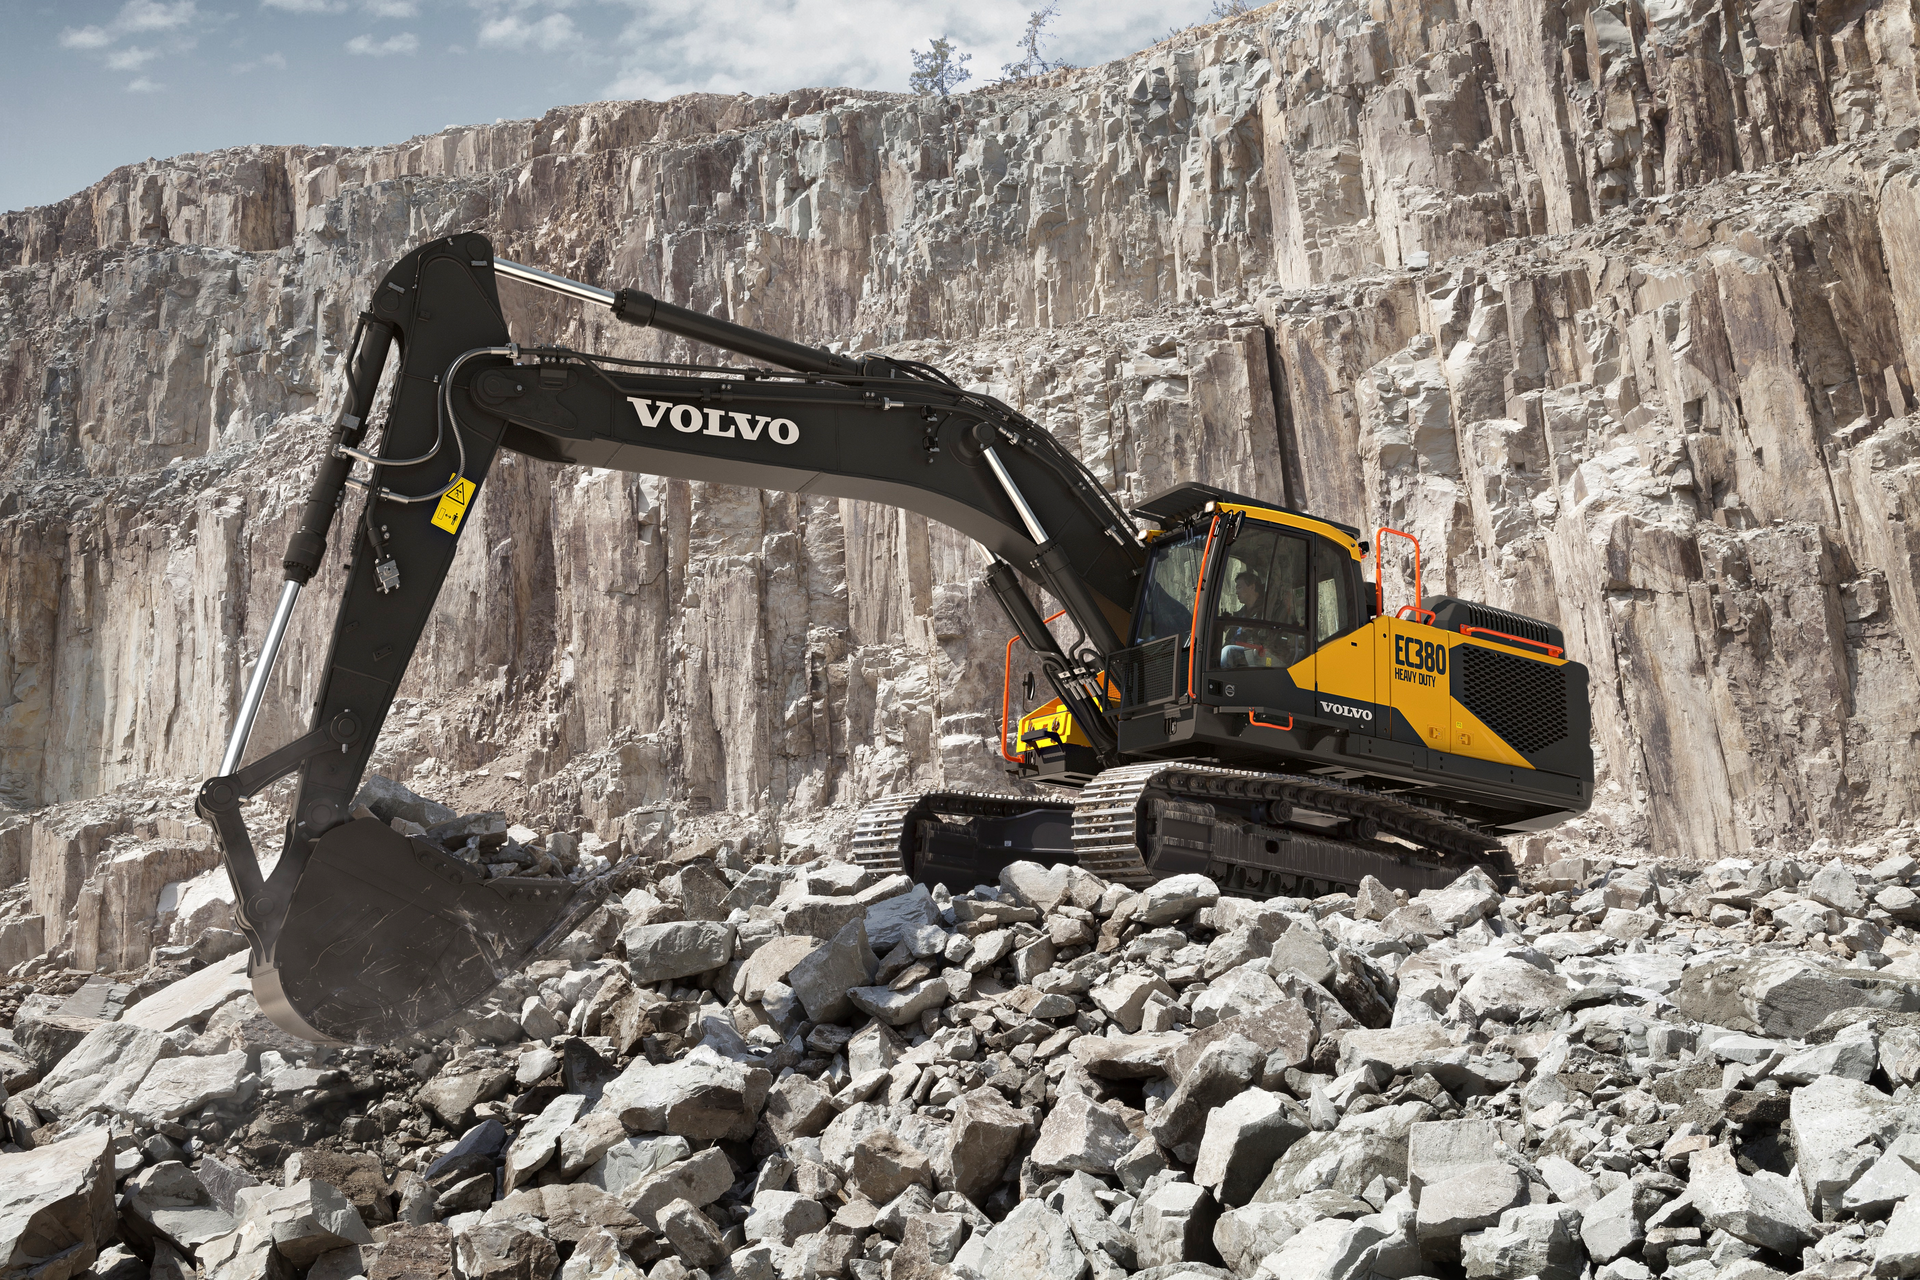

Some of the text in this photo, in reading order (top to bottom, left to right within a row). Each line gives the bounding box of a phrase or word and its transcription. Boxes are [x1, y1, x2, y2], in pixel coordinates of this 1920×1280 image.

[627, 396, 800, 445] VOLVO
[1395, 634, 1447, 675] EC380
[1394, 667, 1436, 688] HEAVY DUTY
[1320, 701, 1373, 721] VOLVO
